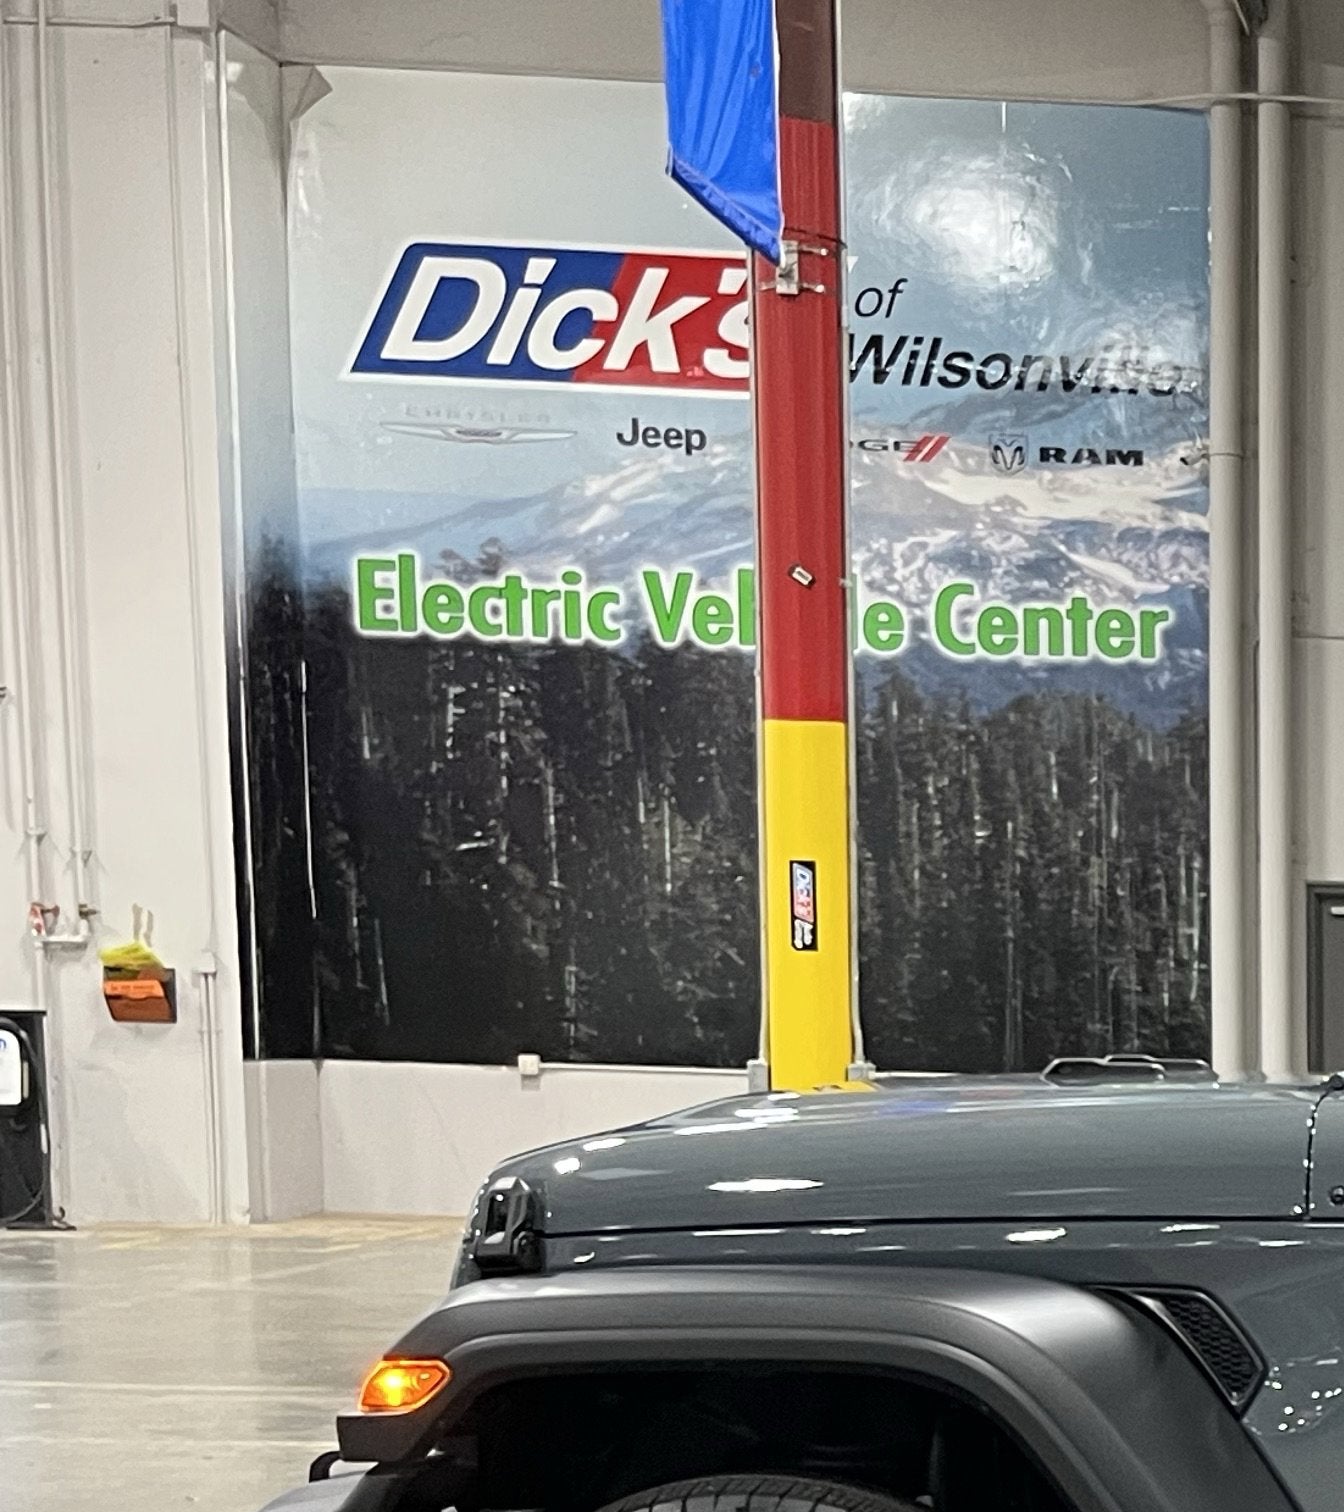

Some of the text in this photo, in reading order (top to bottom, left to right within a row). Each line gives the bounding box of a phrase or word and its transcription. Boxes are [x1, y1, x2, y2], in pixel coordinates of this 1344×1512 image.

[854, 277, 909, 319] of
[616, 418, 707, 456] Jeep
[1038, 446, 1144, 467] RAM
[356, 553, 1170, 658] Electric Vehe Center
